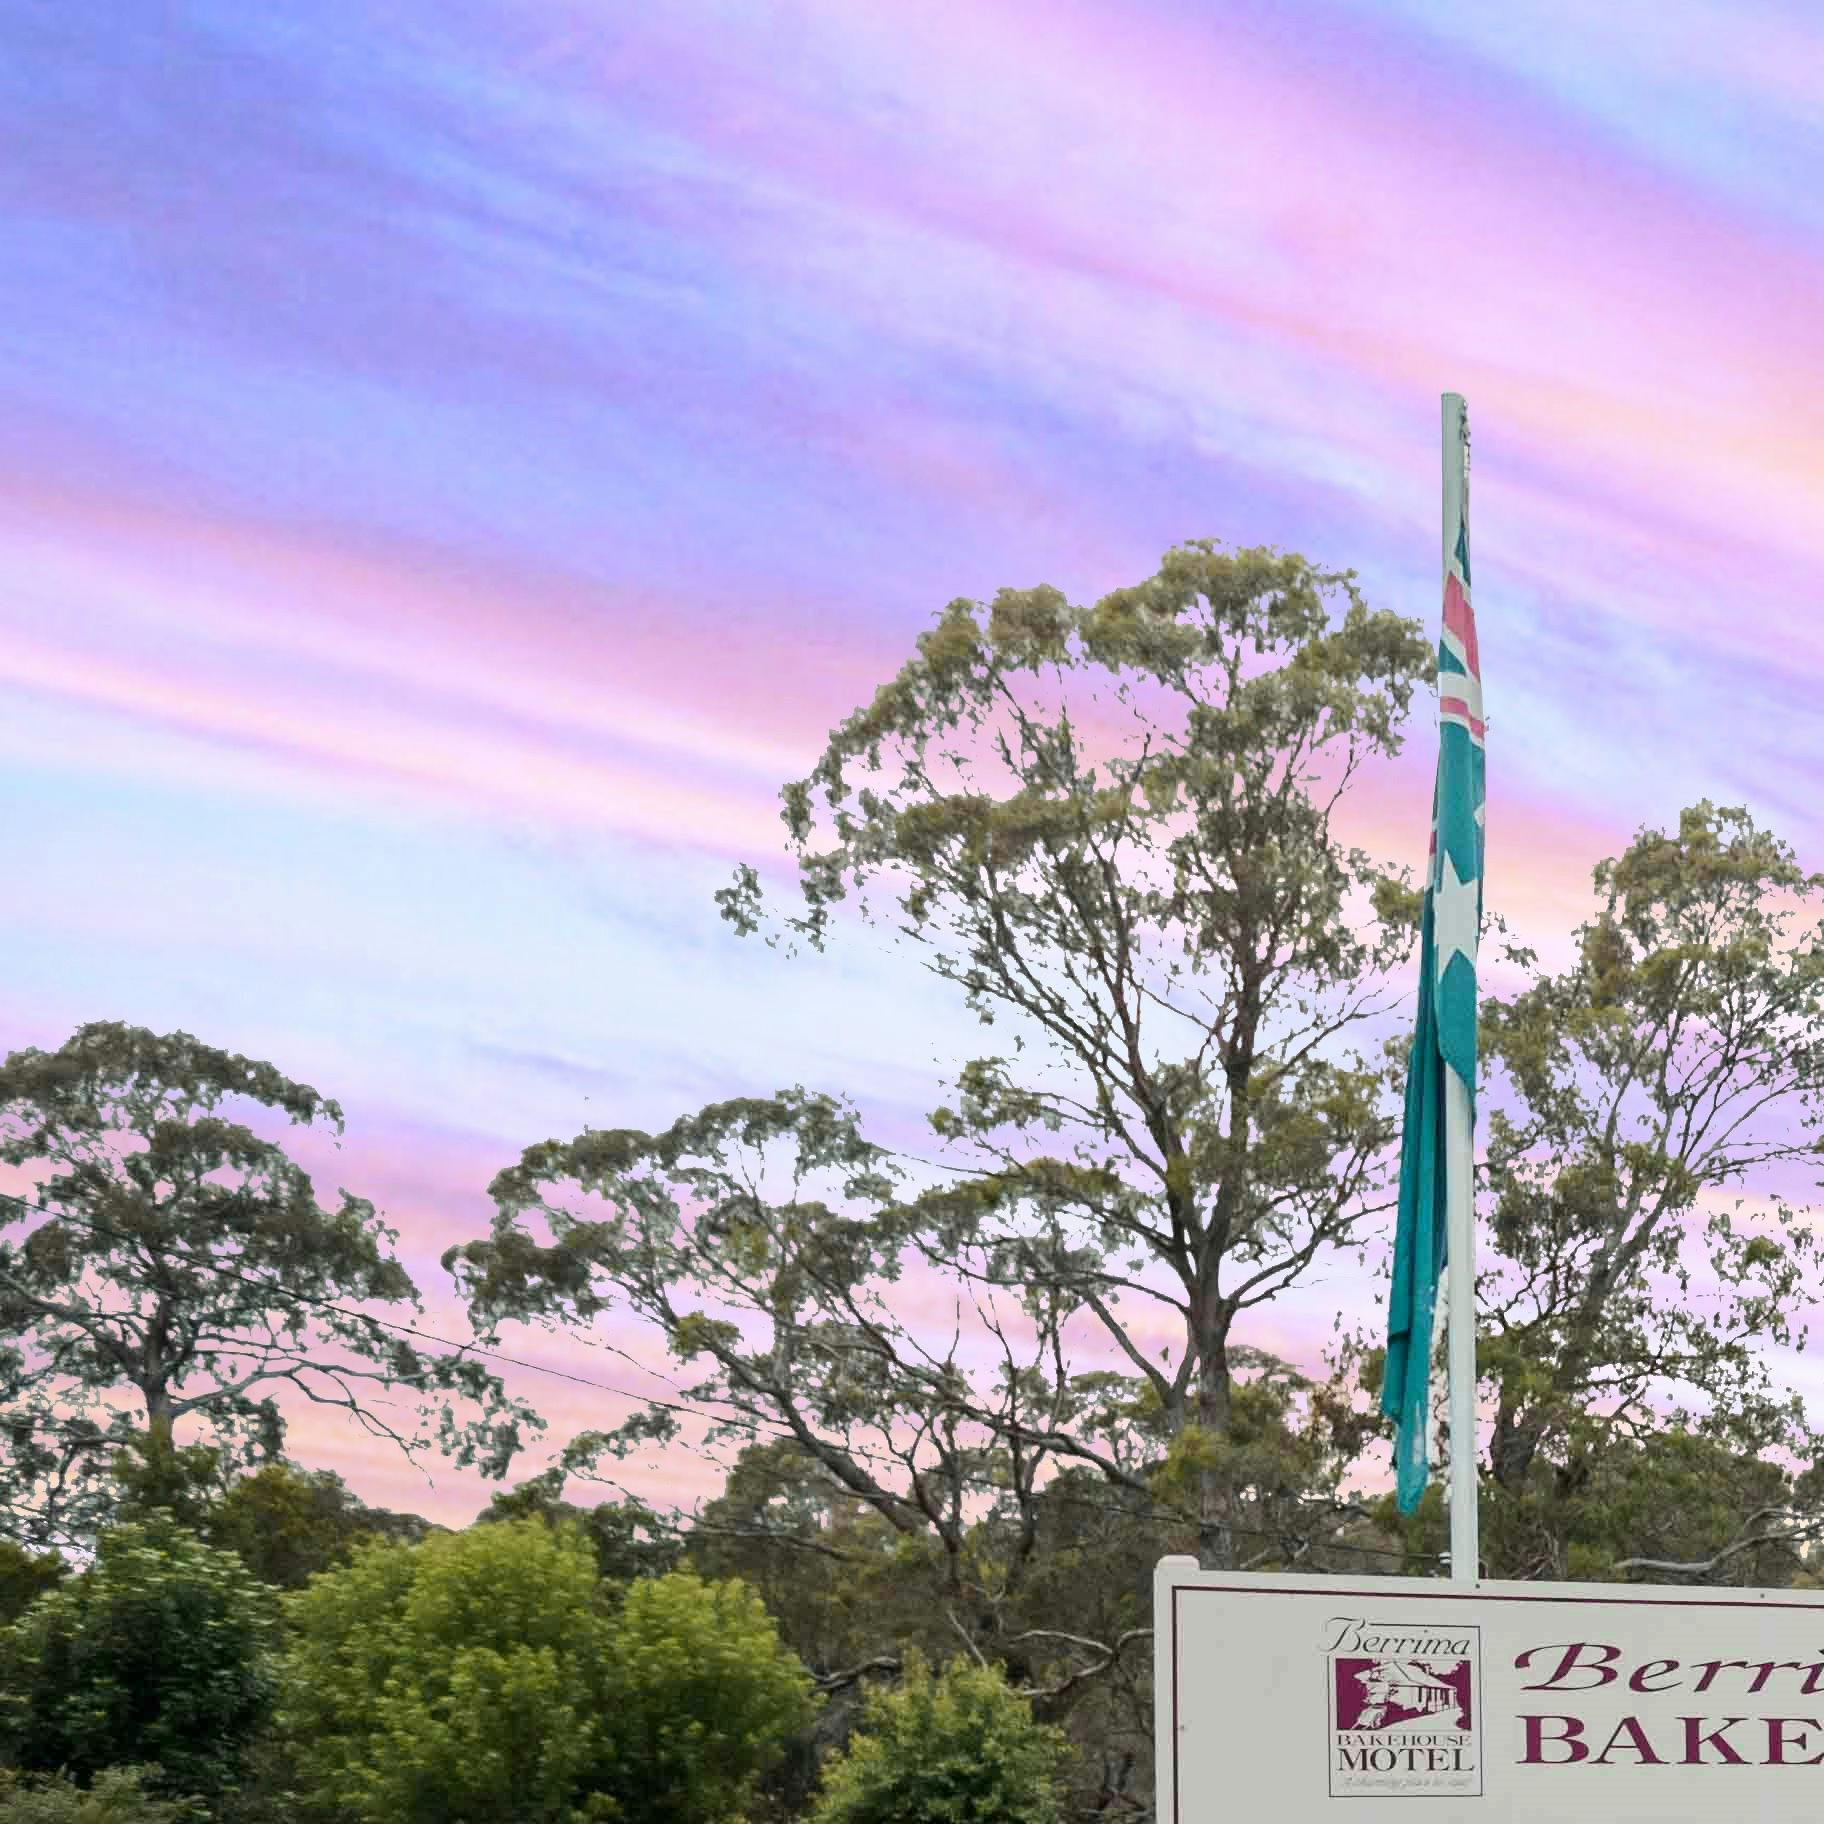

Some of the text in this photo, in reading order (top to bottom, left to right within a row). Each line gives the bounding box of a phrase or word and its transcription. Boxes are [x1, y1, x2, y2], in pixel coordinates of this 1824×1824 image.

[1320, 1616, 1471, 1656] Berrima
[1336, 1734, 1472, 1747] BAKEHOUSE
[1338, 1747, 1475, 1772] MOTEL
